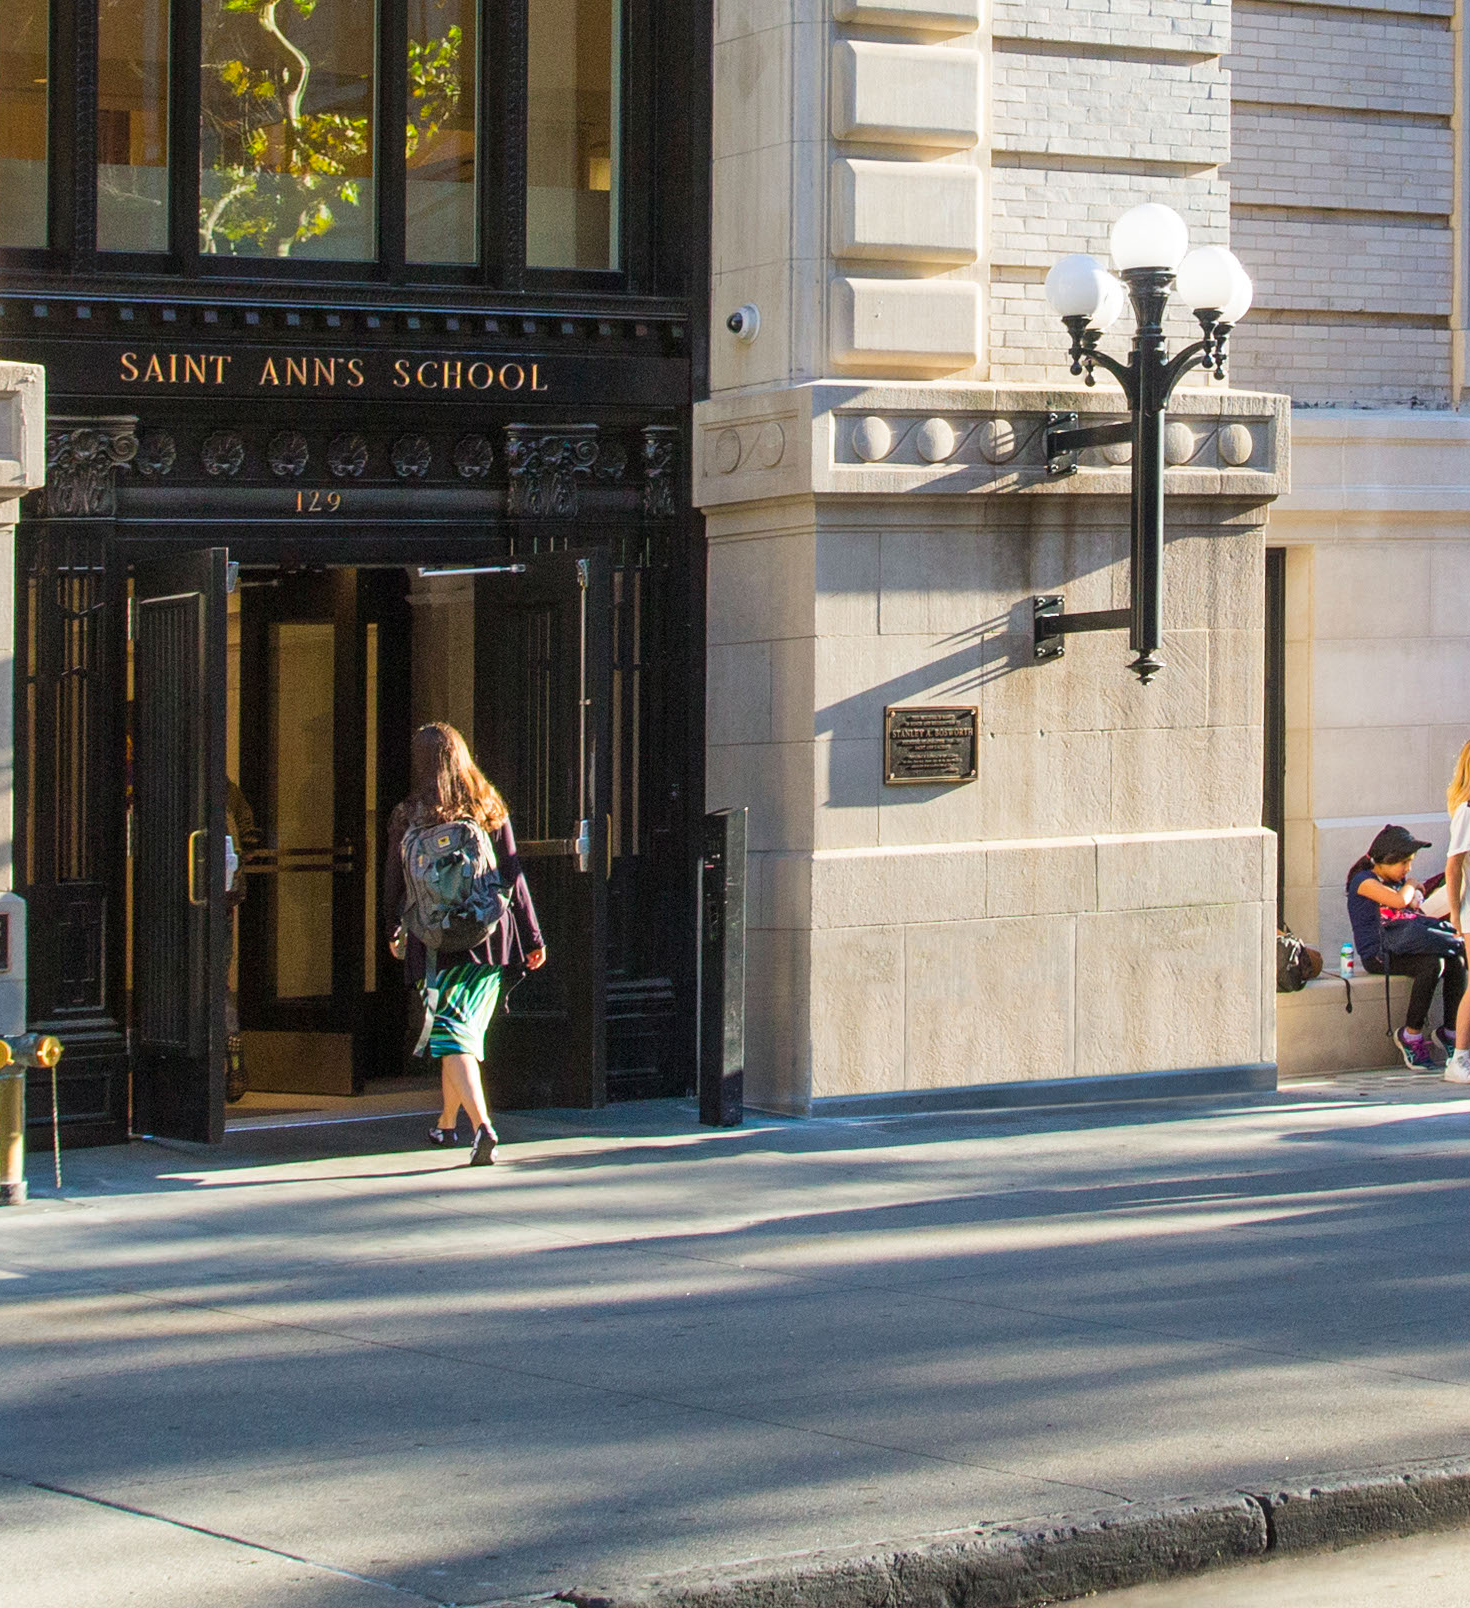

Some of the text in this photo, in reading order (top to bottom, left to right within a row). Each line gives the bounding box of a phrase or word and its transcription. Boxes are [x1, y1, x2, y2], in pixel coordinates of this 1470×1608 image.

[120, 352, 548, 391] SAINT ANN'S SCHOOL
[296, 489, 341, 512] 129
[892, 728, 924, 738] STANLEY
[935, 727, 973, 737] BOSWORTH
